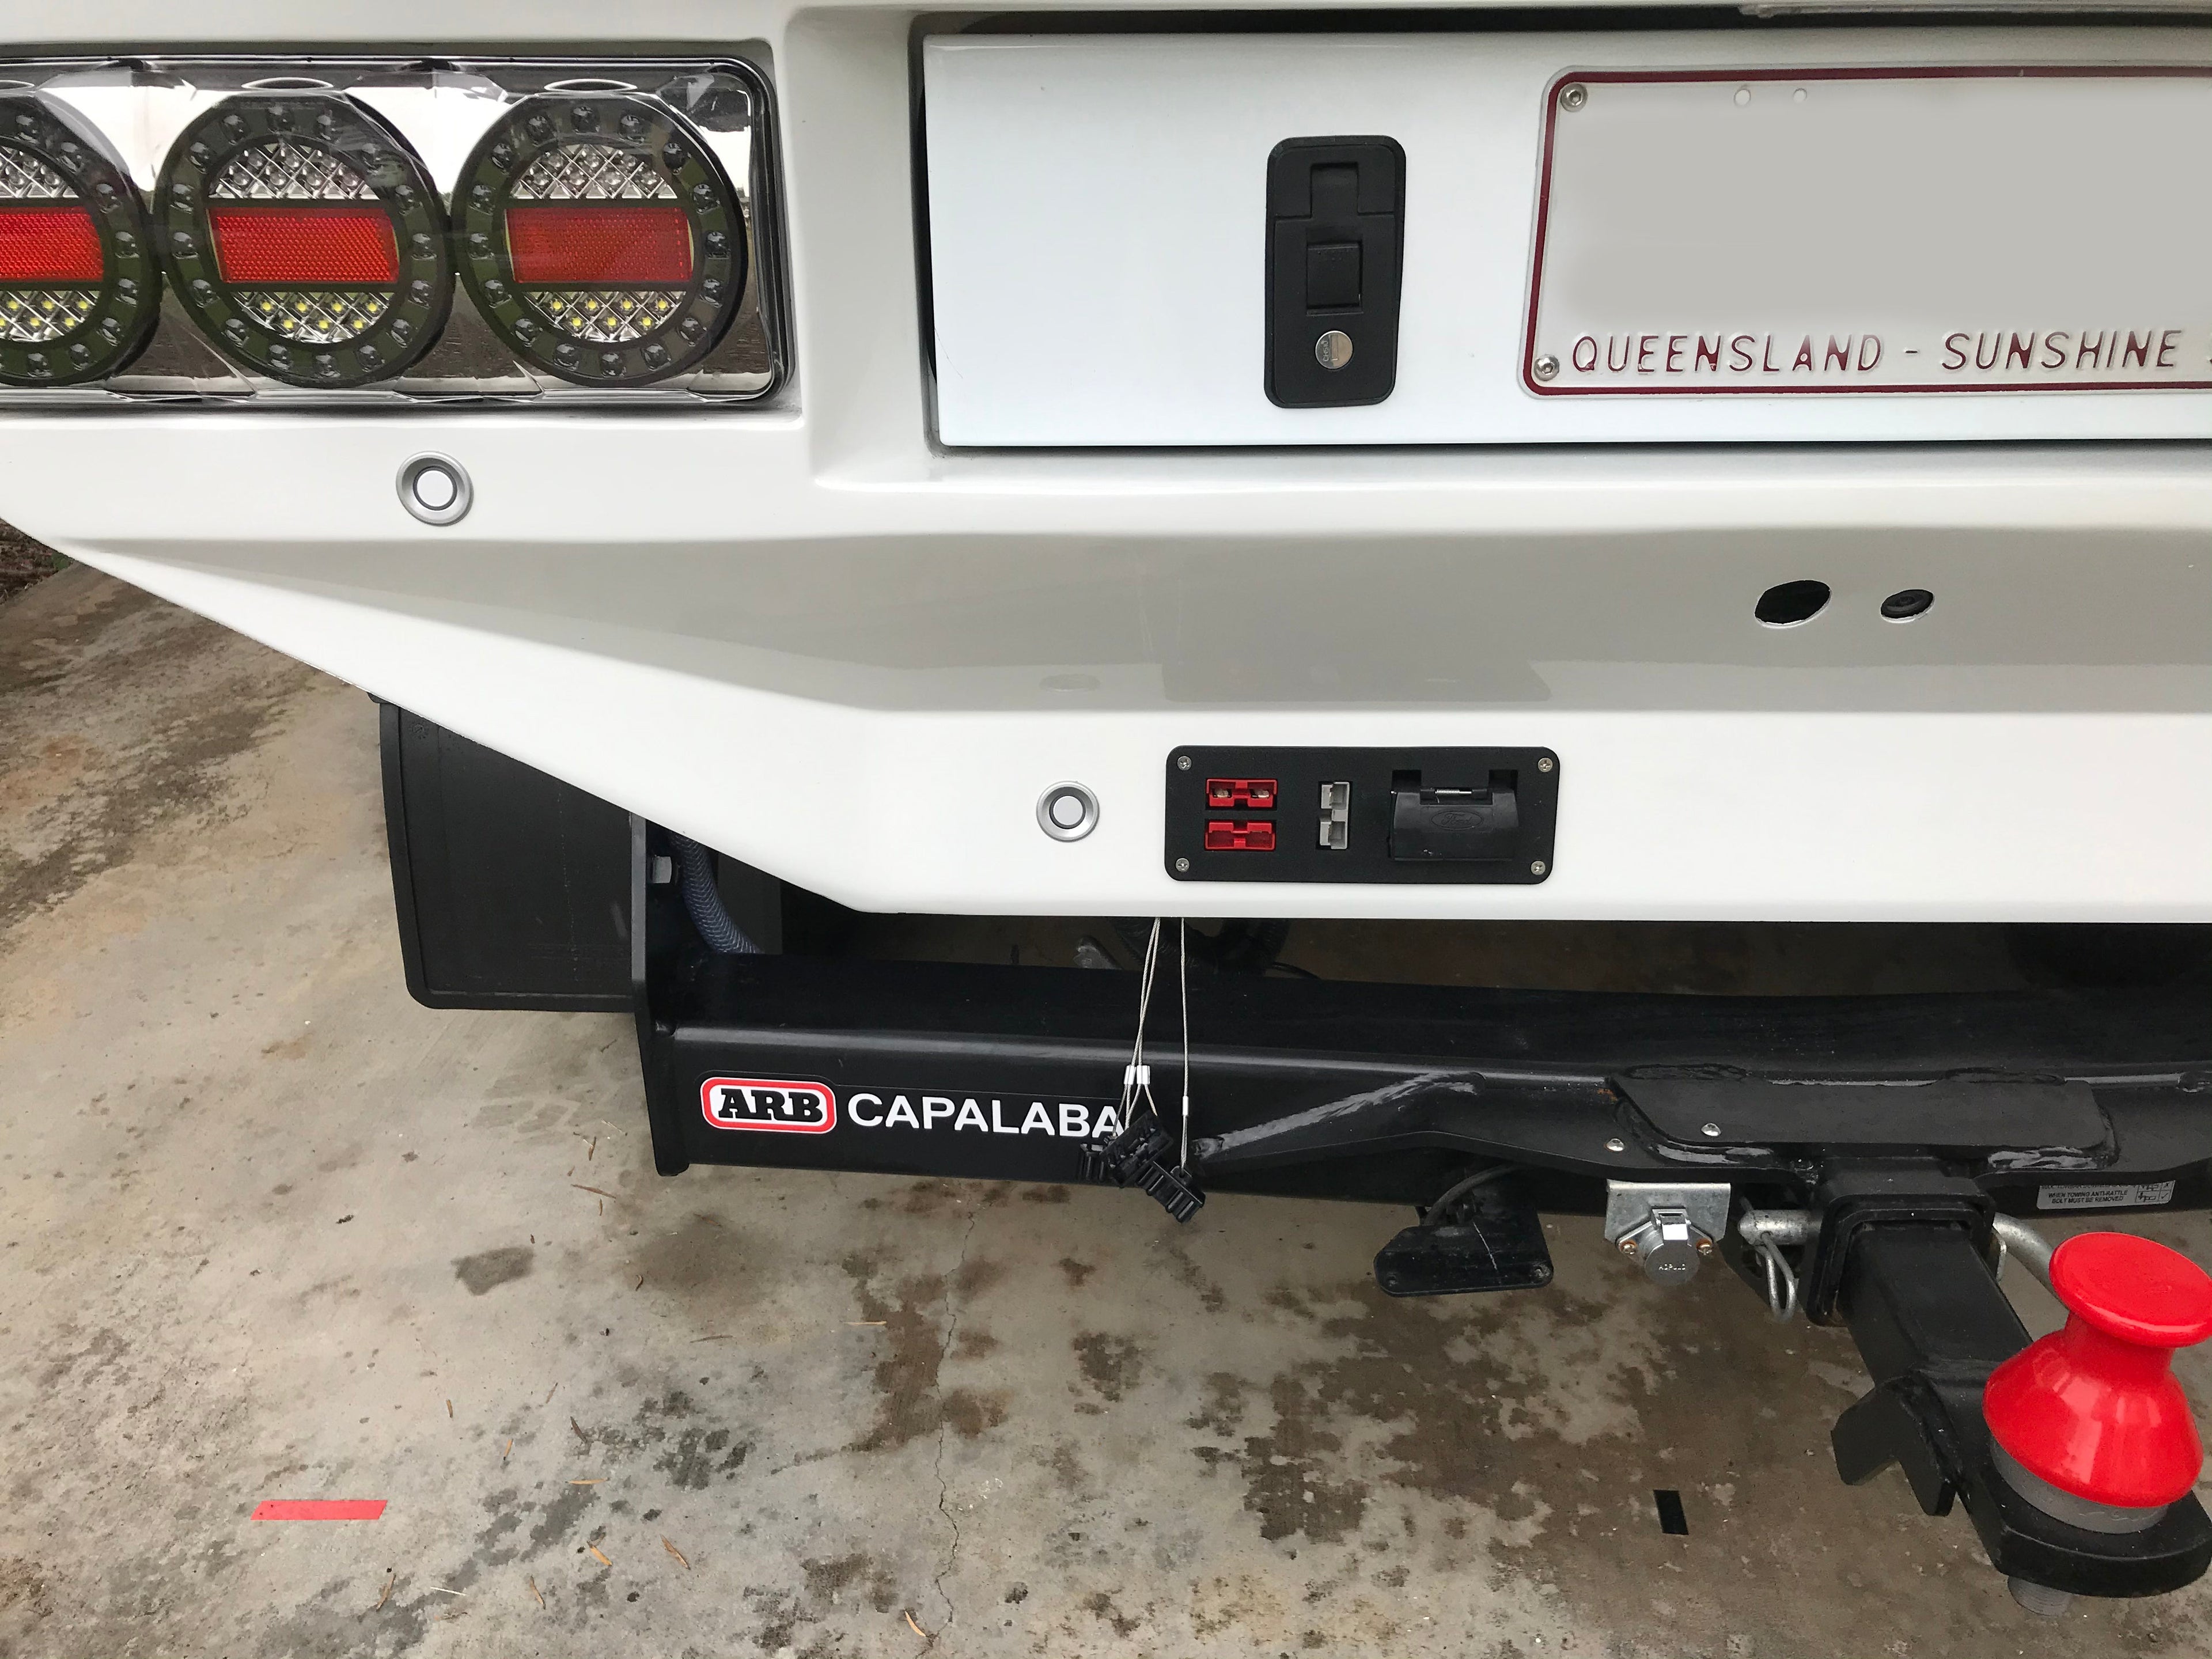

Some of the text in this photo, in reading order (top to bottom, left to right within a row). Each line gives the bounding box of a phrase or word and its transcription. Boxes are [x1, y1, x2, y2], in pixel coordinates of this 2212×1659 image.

[1571, 332, 1883, 373] QUEENSLAND
[1940, 329, 2184, 370] SUNSHINE
[718, 1088, 1125, 1139] ARB CAPALABA
